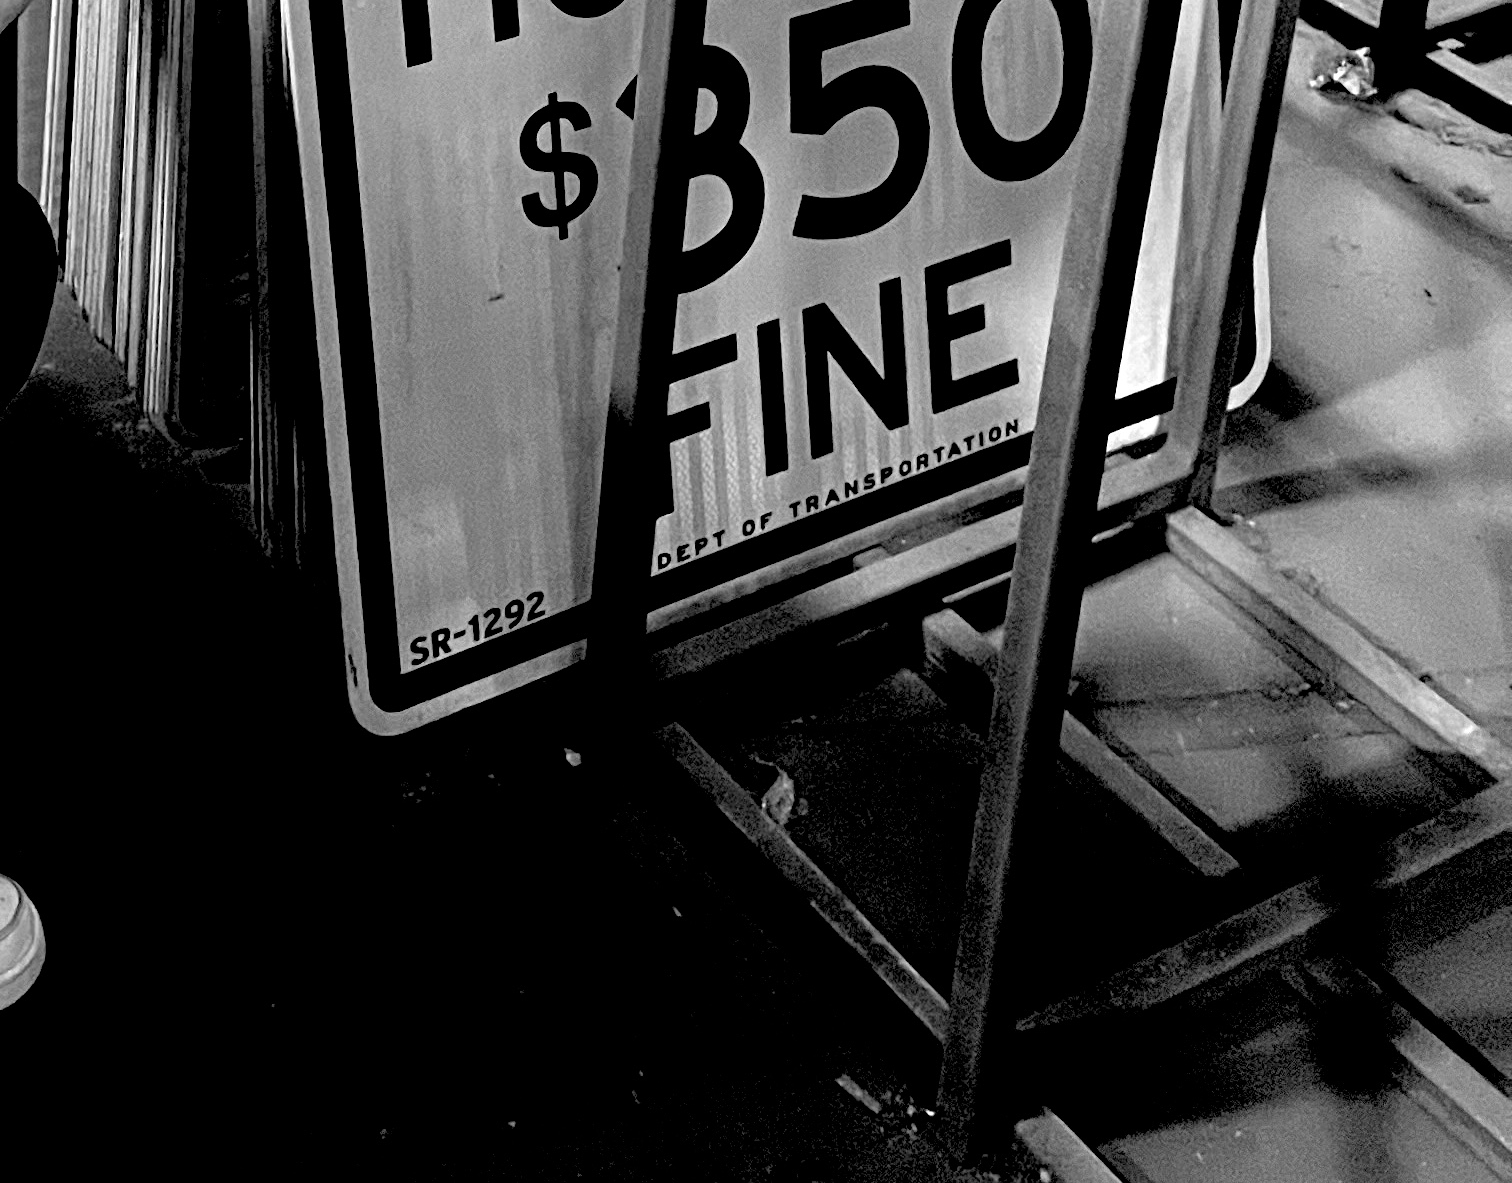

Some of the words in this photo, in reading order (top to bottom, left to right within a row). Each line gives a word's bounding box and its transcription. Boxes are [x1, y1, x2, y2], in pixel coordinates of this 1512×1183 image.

[656, 239, 1020, 520] FINE
[657, 529, 726, 571] DEPT
[742, 512, 773, 537] OF
[789, 419, 1020, 518] TRANSPORTATION
[410, 591, 546, 666] SR-1292
